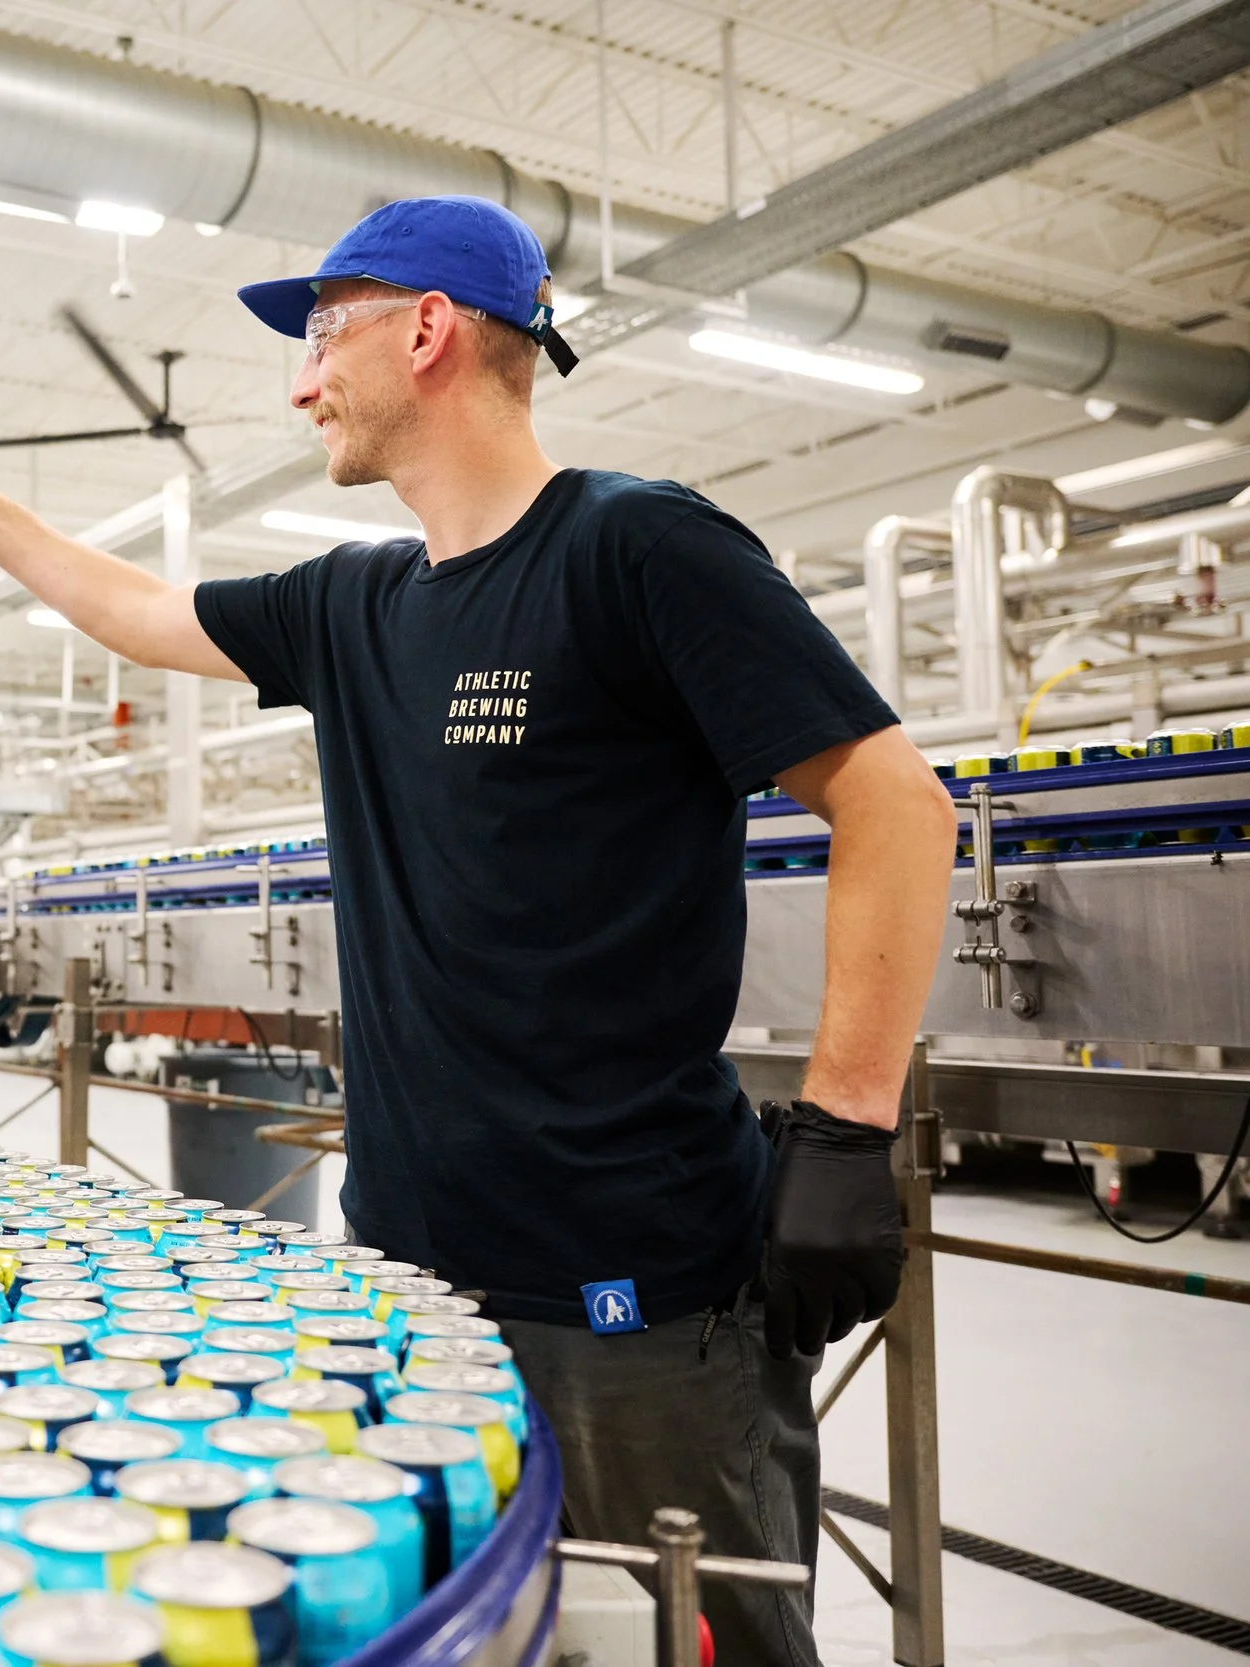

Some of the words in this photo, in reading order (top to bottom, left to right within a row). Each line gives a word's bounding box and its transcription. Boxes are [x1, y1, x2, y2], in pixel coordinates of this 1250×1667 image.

[454, 670, 532, 691] ATHLETIC
[448, 697, 528, 718] BREWING
[444, 724, 526, 745] COMPANY
